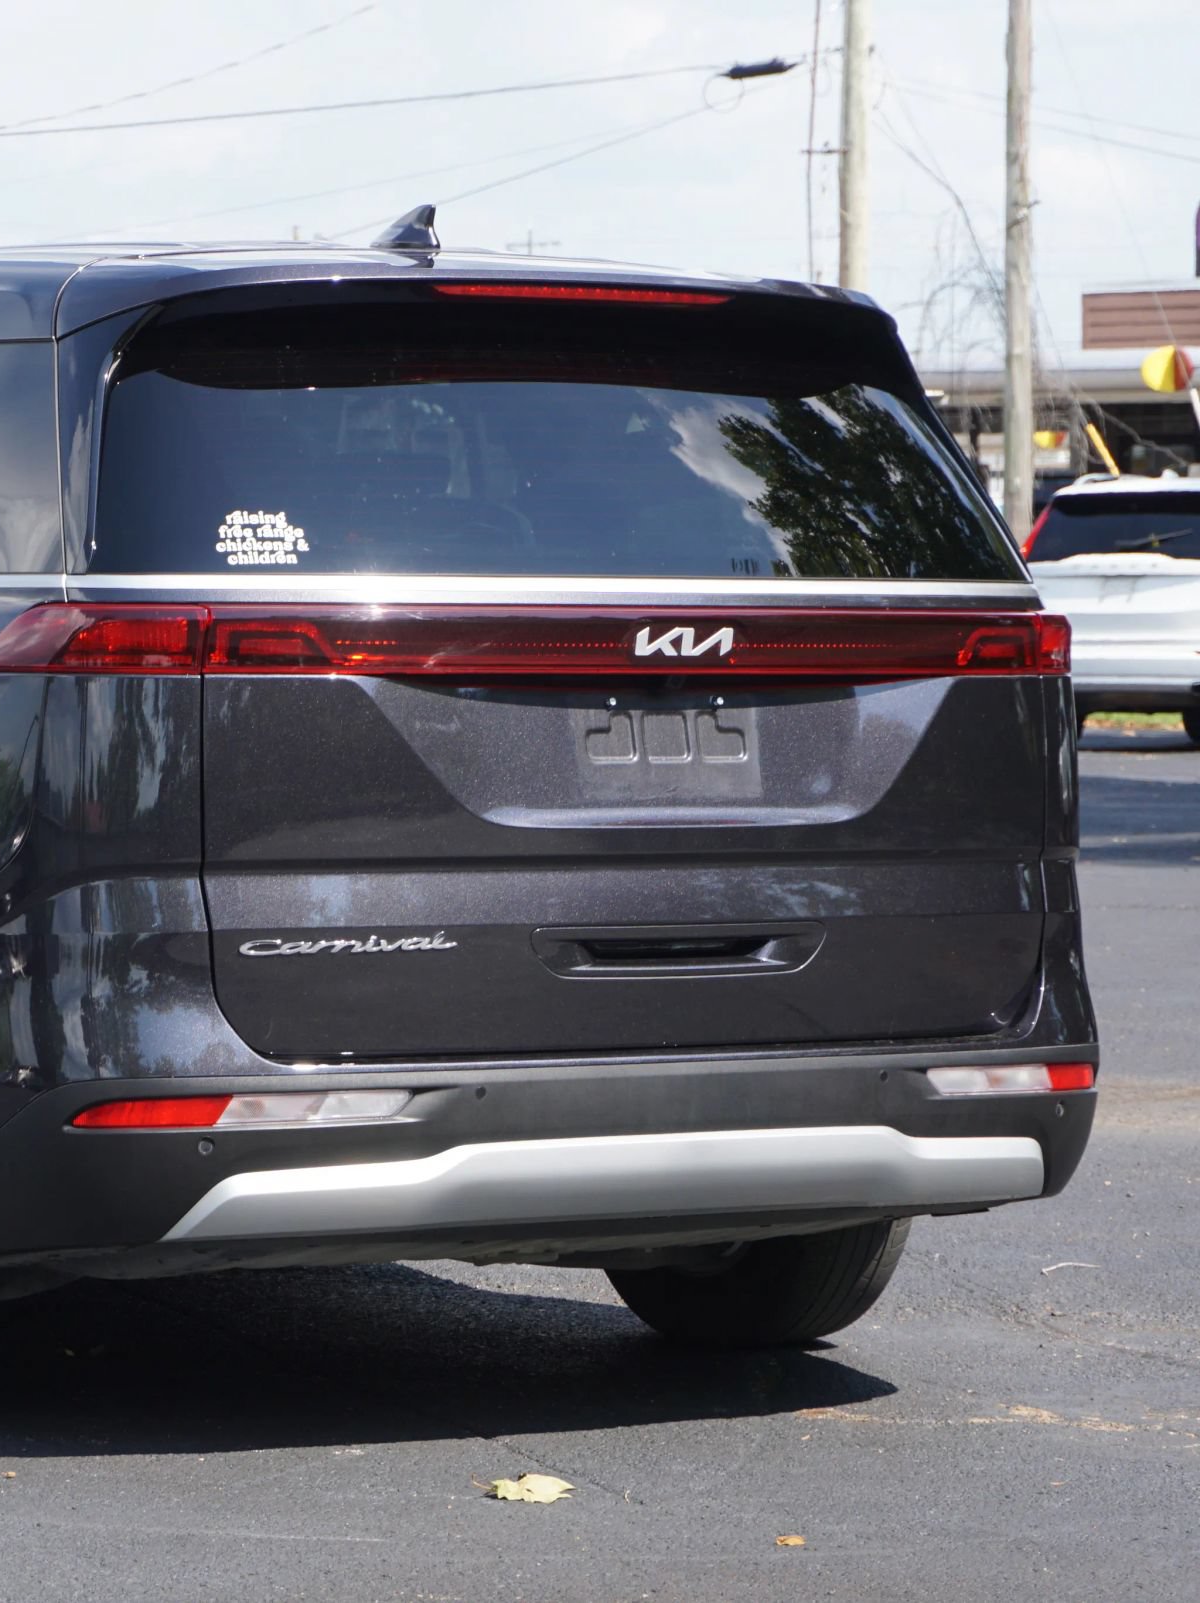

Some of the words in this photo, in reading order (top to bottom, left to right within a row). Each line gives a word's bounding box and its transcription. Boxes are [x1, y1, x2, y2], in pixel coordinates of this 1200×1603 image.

[225, 510, 288, 529] raising
[218, 524, 254, 539] free
[256, 524, 305, 542] range
[215, 537, 294, 553] chickens
[296, 538, 310, 552] &
[227, 550, 298, 566] children
[634, 626, 734, 657] KIA
[239, 930, 458, 957] Carnival
